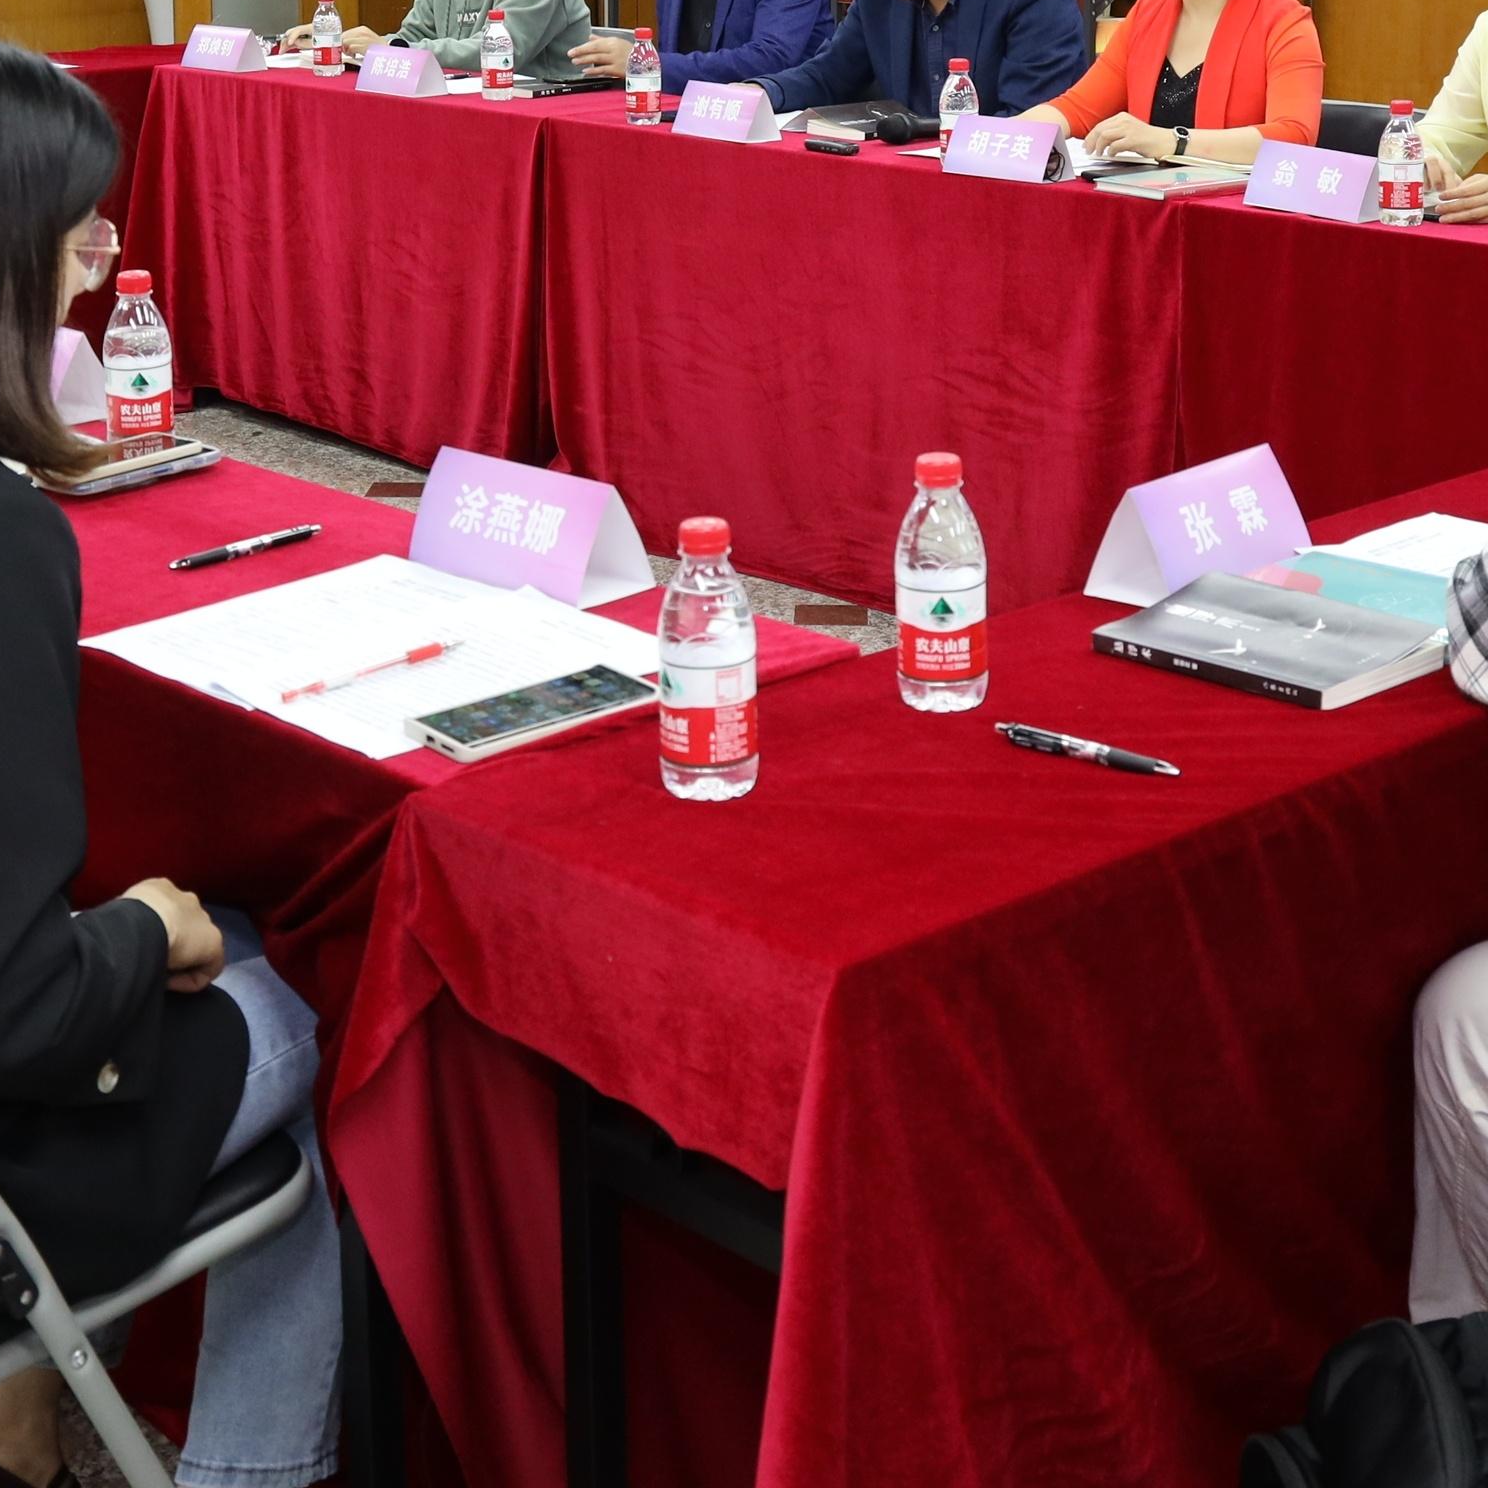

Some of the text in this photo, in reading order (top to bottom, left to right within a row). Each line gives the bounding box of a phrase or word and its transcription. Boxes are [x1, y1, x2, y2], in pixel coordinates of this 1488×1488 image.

[692, 95, 743, 122] 谢有顺
[968, 129, 1033, 160] 胡子英
[449, 483, 567, 555] 涂燕娜
